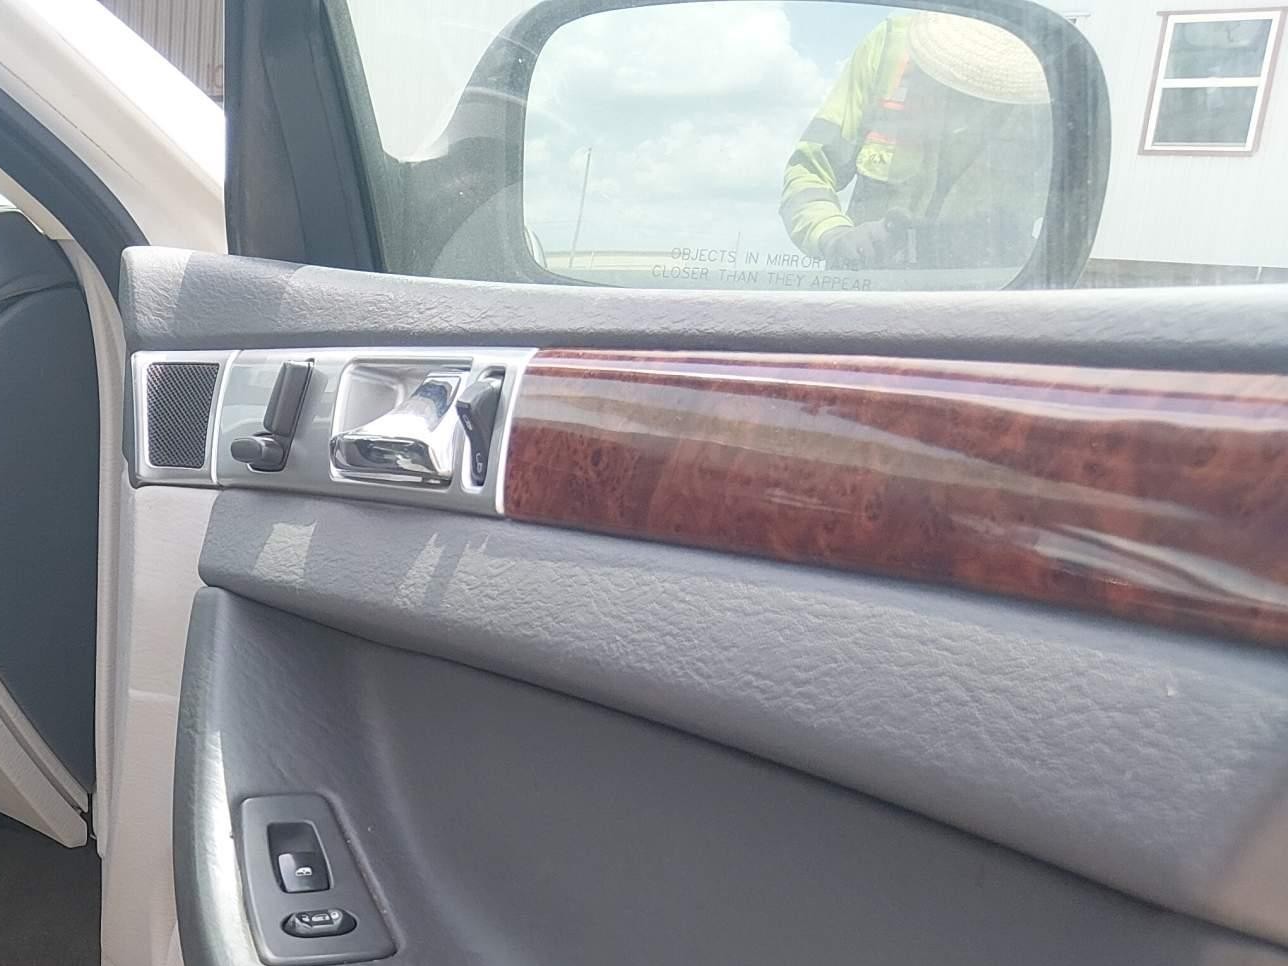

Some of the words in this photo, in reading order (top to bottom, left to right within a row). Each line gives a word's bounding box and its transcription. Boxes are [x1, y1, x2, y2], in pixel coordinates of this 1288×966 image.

[671, 248, 736, 263] OBJECTS
[745, 252, 759, 264] IN
[767, 253, 822, 268] MIRROR
[652, 265, 710, 280] CLOSER
[720, 269, 759, 283] THAN
[768, 272, 805, 287] THEY
[810, 275, 872, 291] APPEAR
